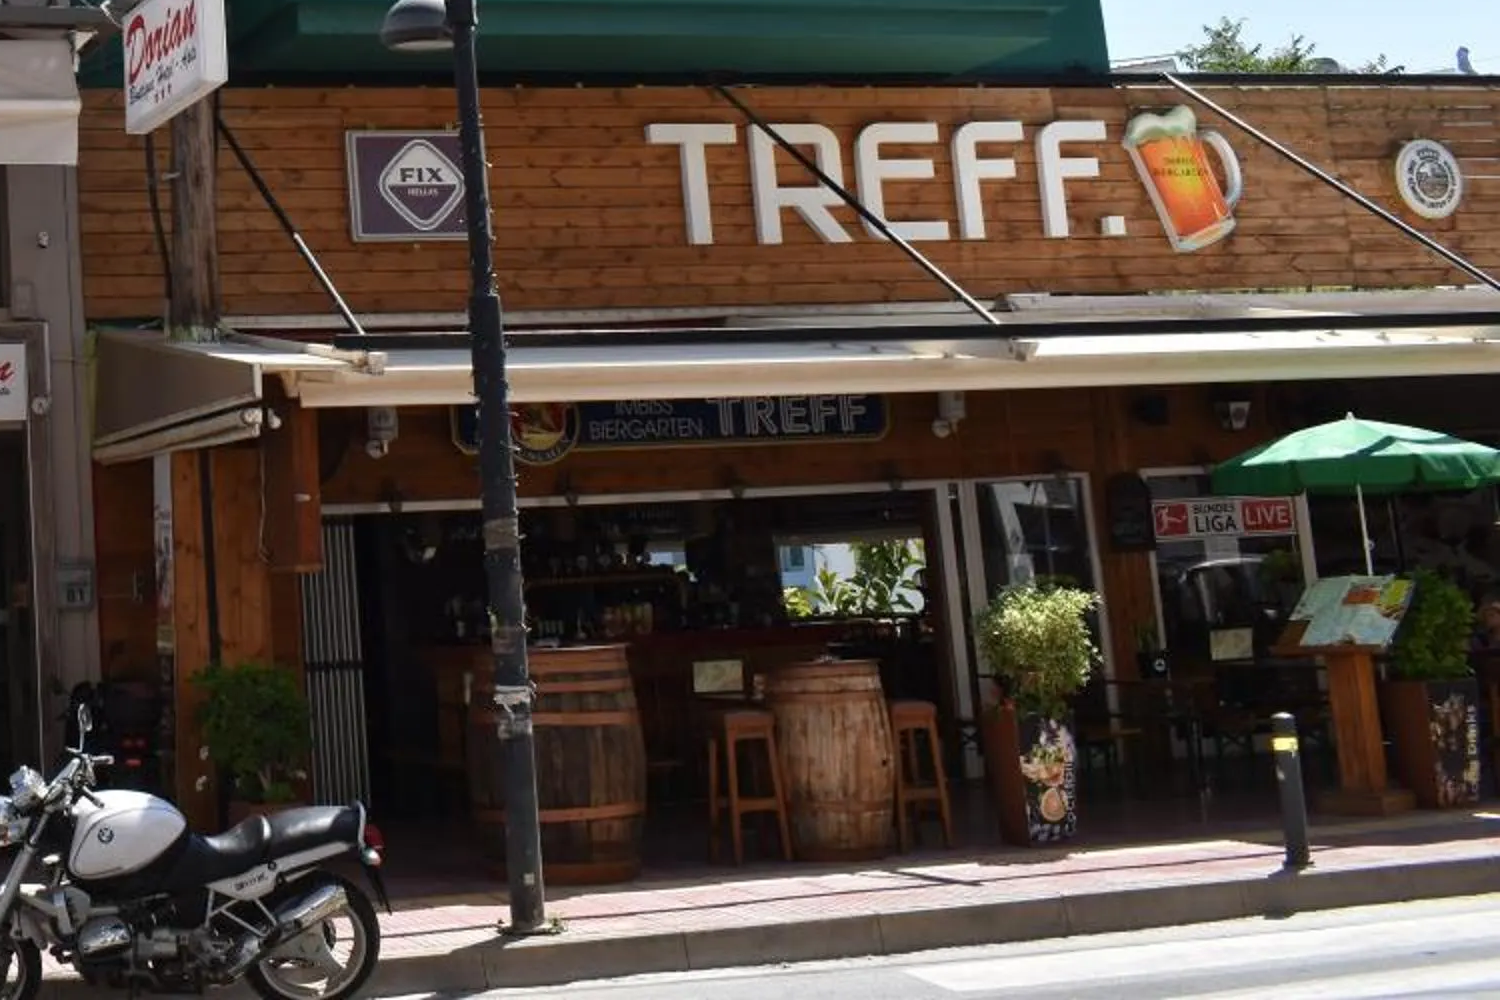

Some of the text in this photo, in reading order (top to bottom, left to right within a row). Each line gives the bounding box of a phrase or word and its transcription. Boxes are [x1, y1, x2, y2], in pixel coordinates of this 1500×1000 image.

[400, 168, 445, 182] FIX
[645, 120, 1126, 245] TREFF.
[707, 395, 867, 436] TREFF
[588, 417, 704, 440] BIERGARTEN
[1195, 515, 1239, 533] LIGA
[1245, 505, 1290, 526] LIVE
